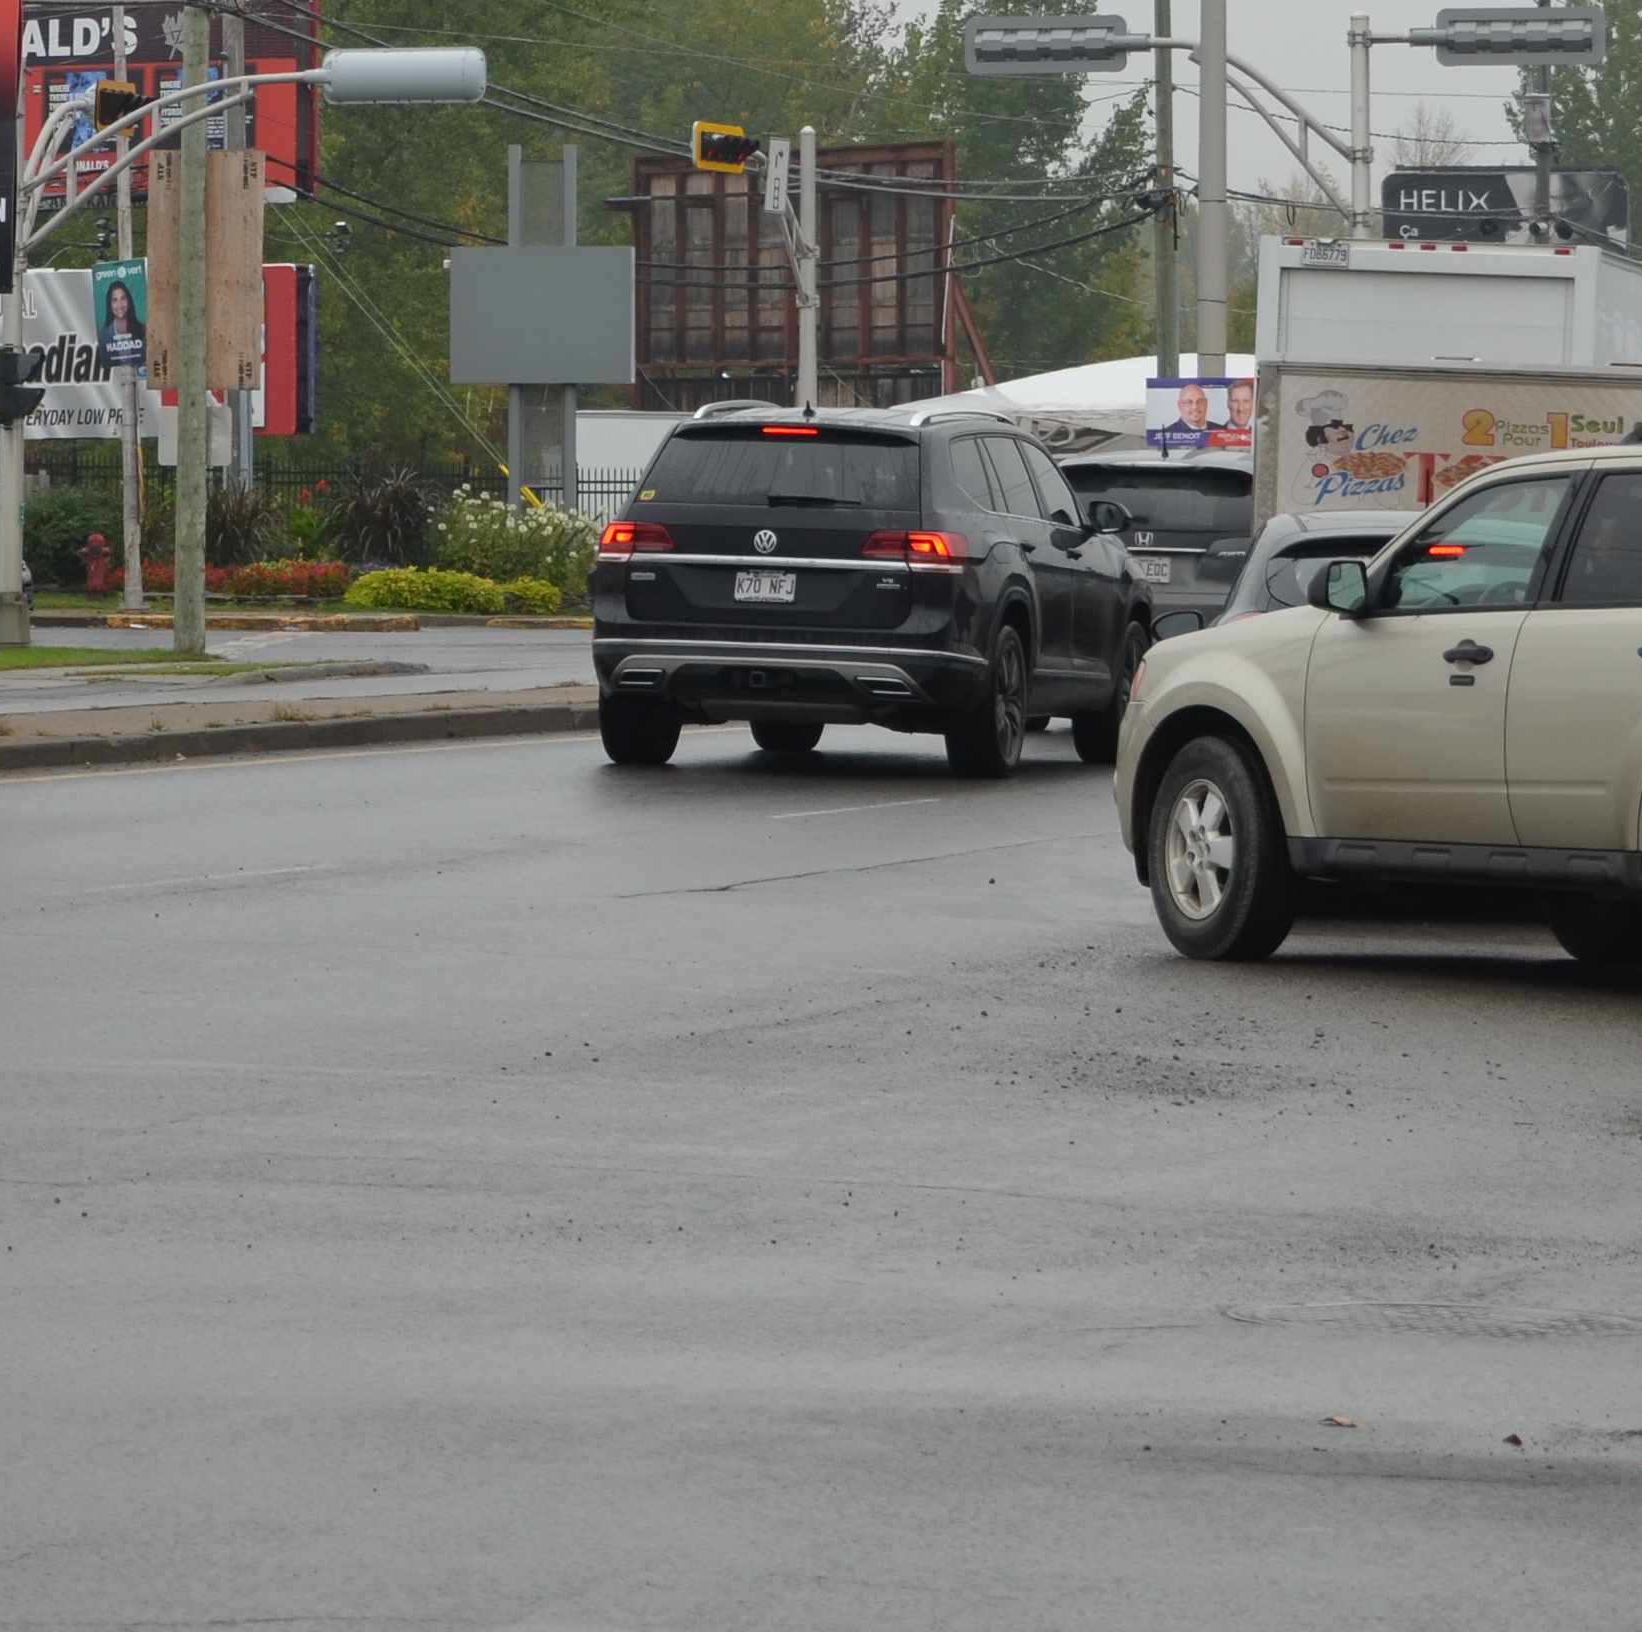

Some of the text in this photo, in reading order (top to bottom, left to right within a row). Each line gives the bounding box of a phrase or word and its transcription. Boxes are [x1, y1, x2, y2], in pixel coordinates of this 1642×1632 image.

[1399, 189, 1491, 212] HELIX
[106, 339, 143, 353] HADDAD
[77, 408, 105, 425] LOW
[1570, 414, 1624, 434] Seul
[1172, 432, 1201, 440] BENOIT
[1356, 423, 1419, 451] Chez
[1502, 433, 1541, 447] Pour
[1314, 470, 1407, 506] Pizzas
[736, 579, 794, 595] K70 NFJ
